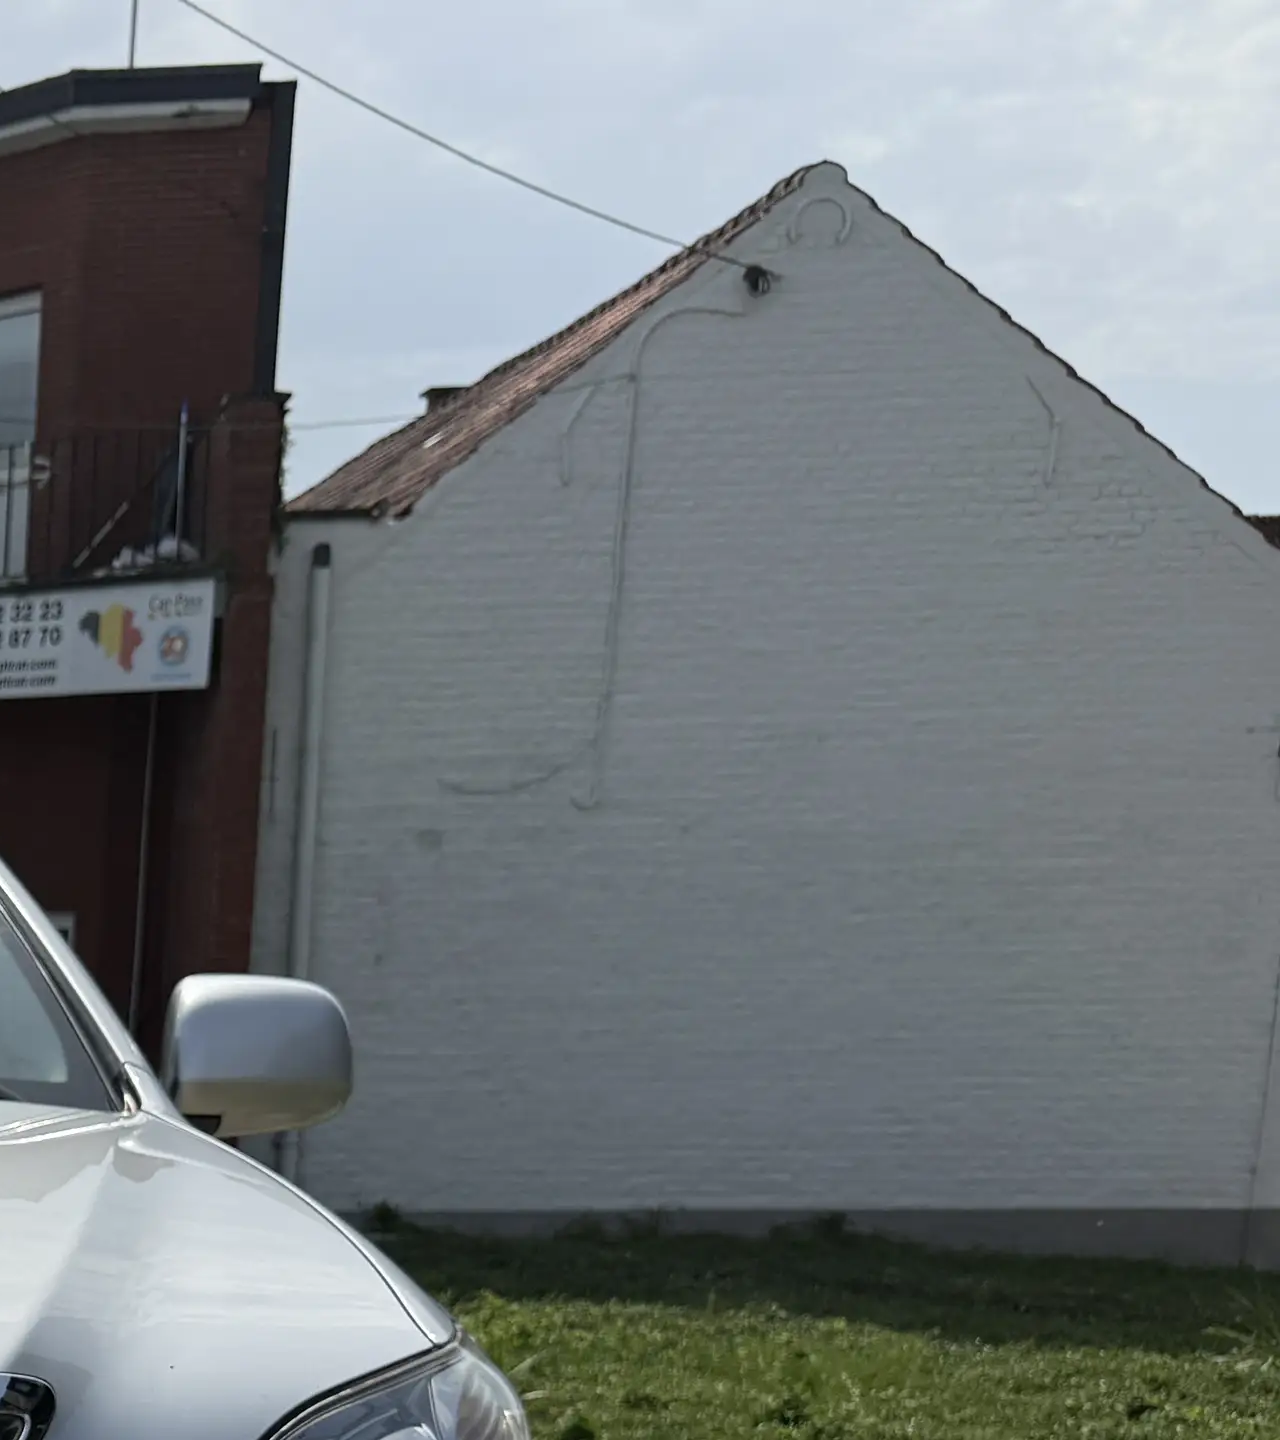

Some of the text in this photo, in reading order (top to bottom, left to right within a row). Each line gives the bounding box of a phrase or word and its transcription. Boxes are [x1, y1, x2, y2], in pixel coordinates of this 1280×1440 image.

[10, 599, 32, 623] 32
[39, 599, 64, 621] 23
[39, 625, 62, 647] 70
